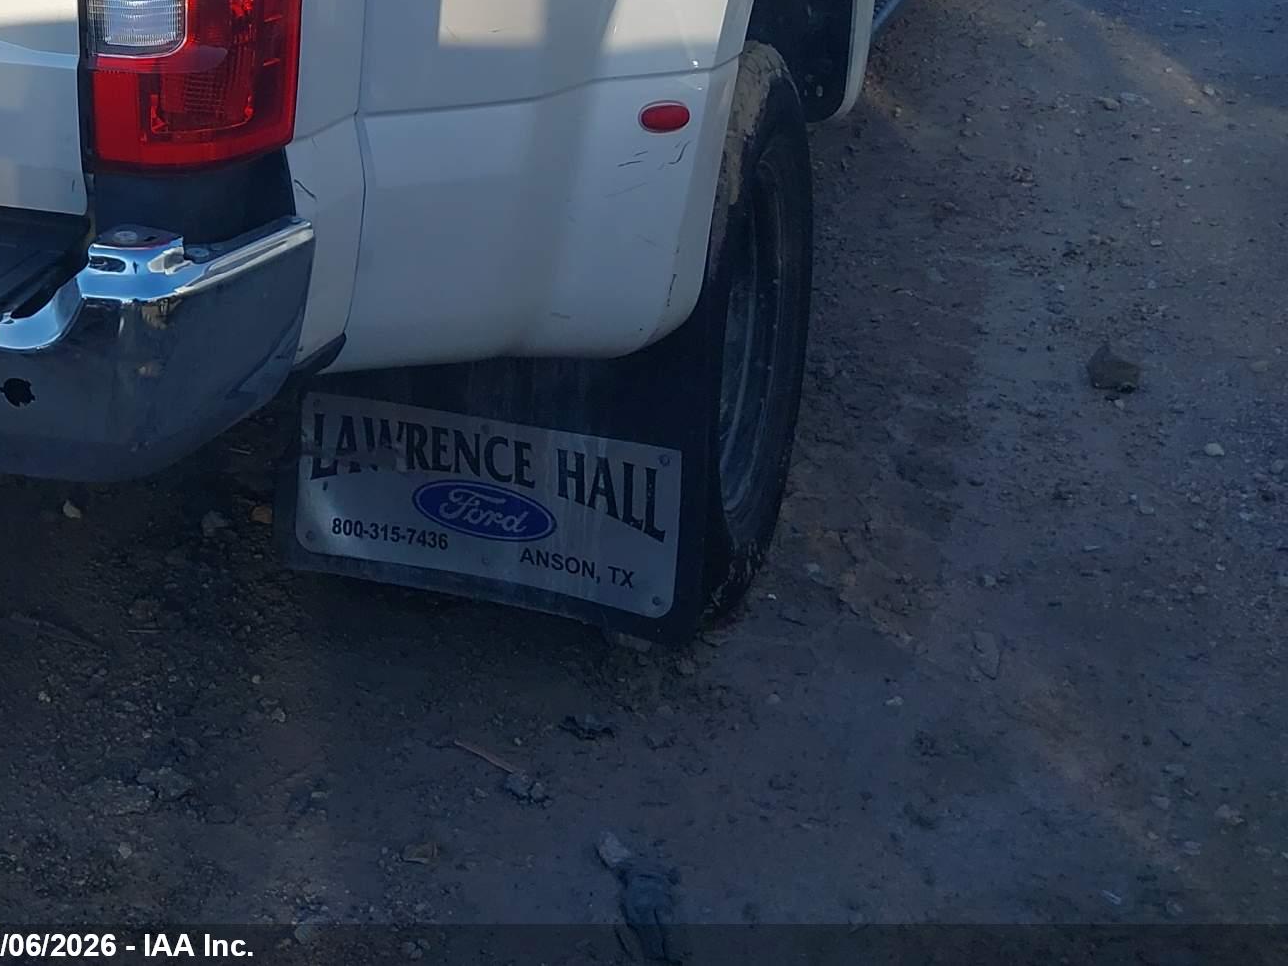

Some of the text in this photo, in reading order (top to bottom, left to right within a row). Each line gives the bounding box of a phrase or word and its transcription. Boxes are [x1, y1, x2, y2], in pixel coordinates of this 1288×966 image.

[311, 413, 666, 542] LAWRENCE HALL
[438, 488, 530, 534] Ford
[332, 517, 449, 551] 800-315-7436
[519, 547, 636, 589] ANSON, TX
